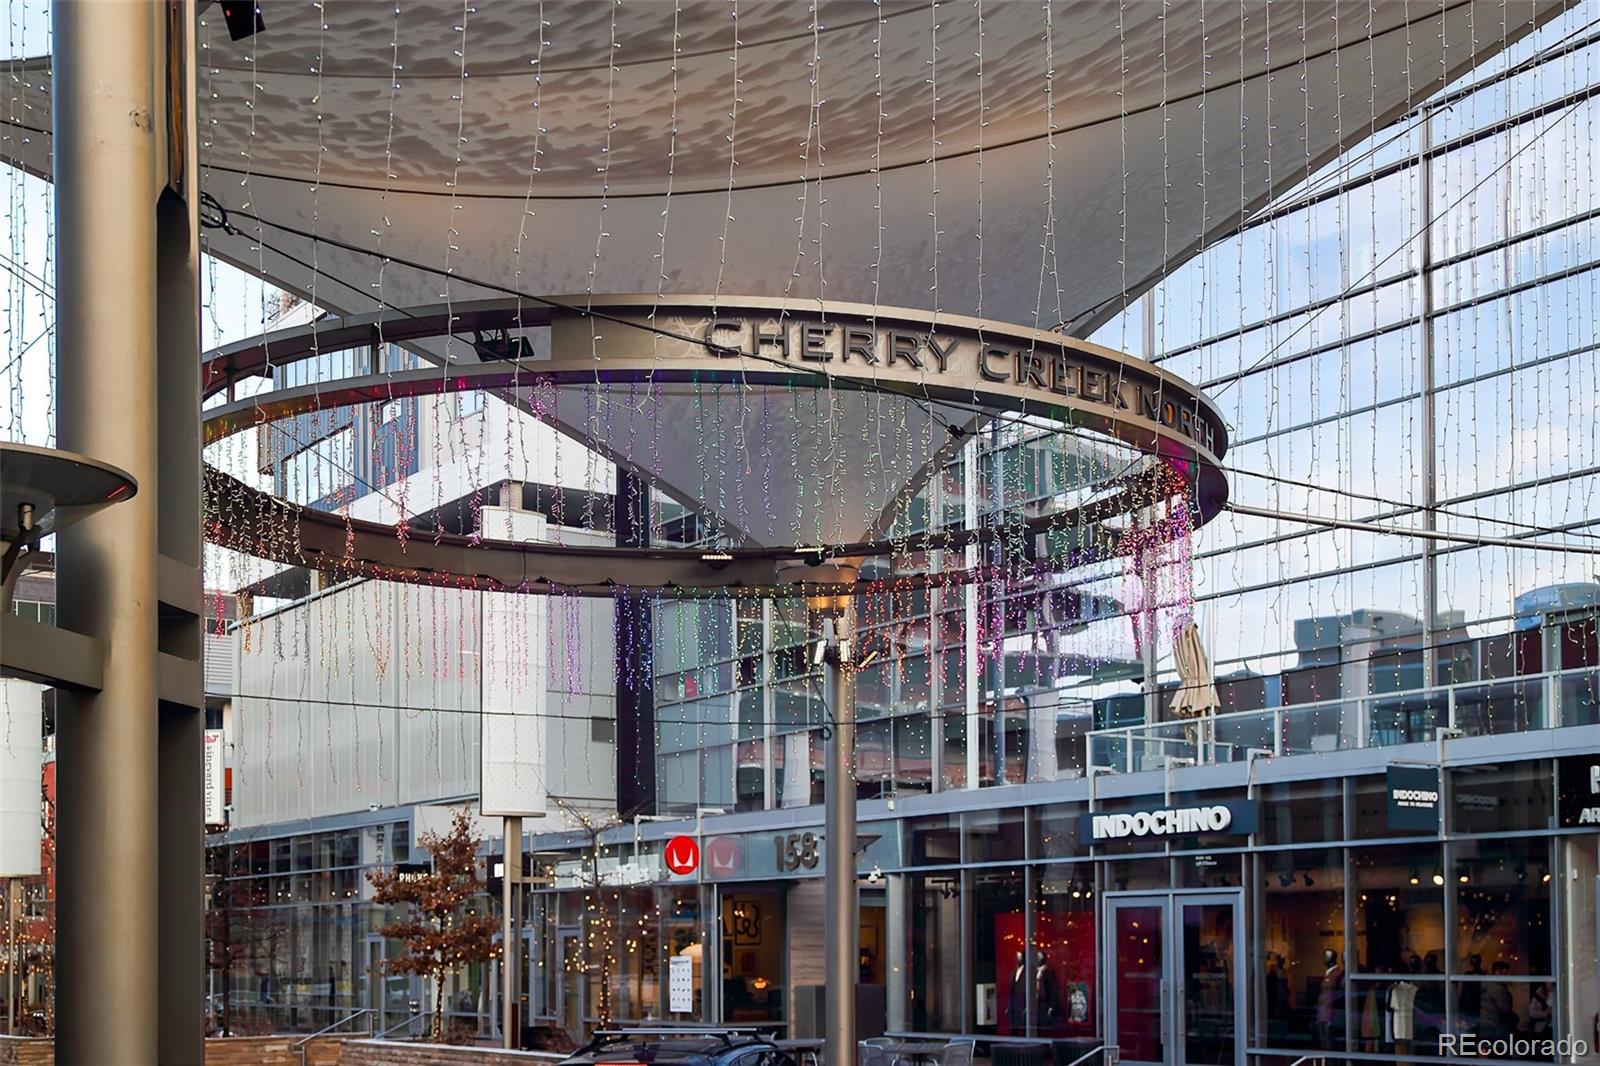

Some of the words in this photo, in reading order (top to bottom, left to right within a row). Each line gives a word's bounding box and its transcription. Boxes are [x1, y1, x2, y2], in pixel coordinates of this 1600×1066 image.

[704, 319, 960, 373] CHERRY
[979, 345, 1129, 410] CREEK
[1136, 383, 1215, 453] NORTH
[1092, 805, 1232, 839] INDOCHINO
[773, 831, 819, 872] 158
